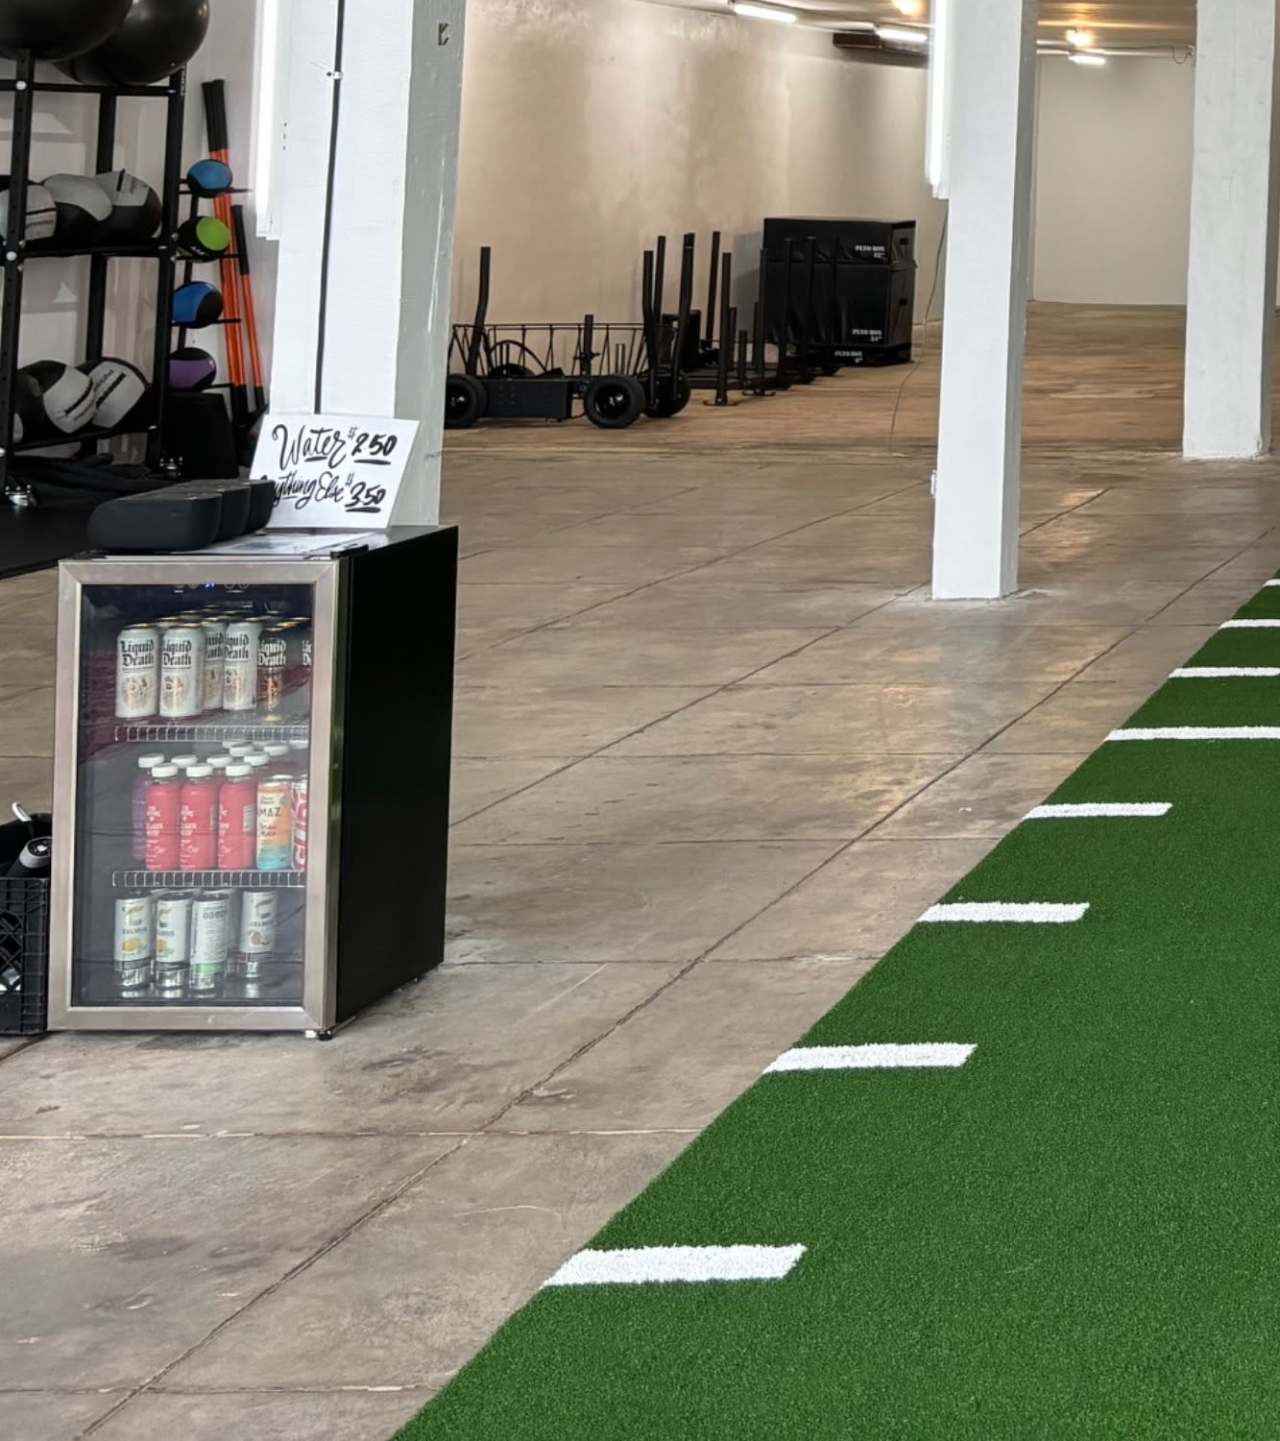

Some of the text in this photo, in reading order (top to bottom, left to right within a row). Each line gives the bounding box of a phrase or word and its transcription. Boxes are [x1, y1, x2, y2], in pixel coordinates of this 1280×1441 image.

[272, 423, 346, 471] Water
[120, 639, 155, 656] Liquid
[122, 653, 154, 667] Death
